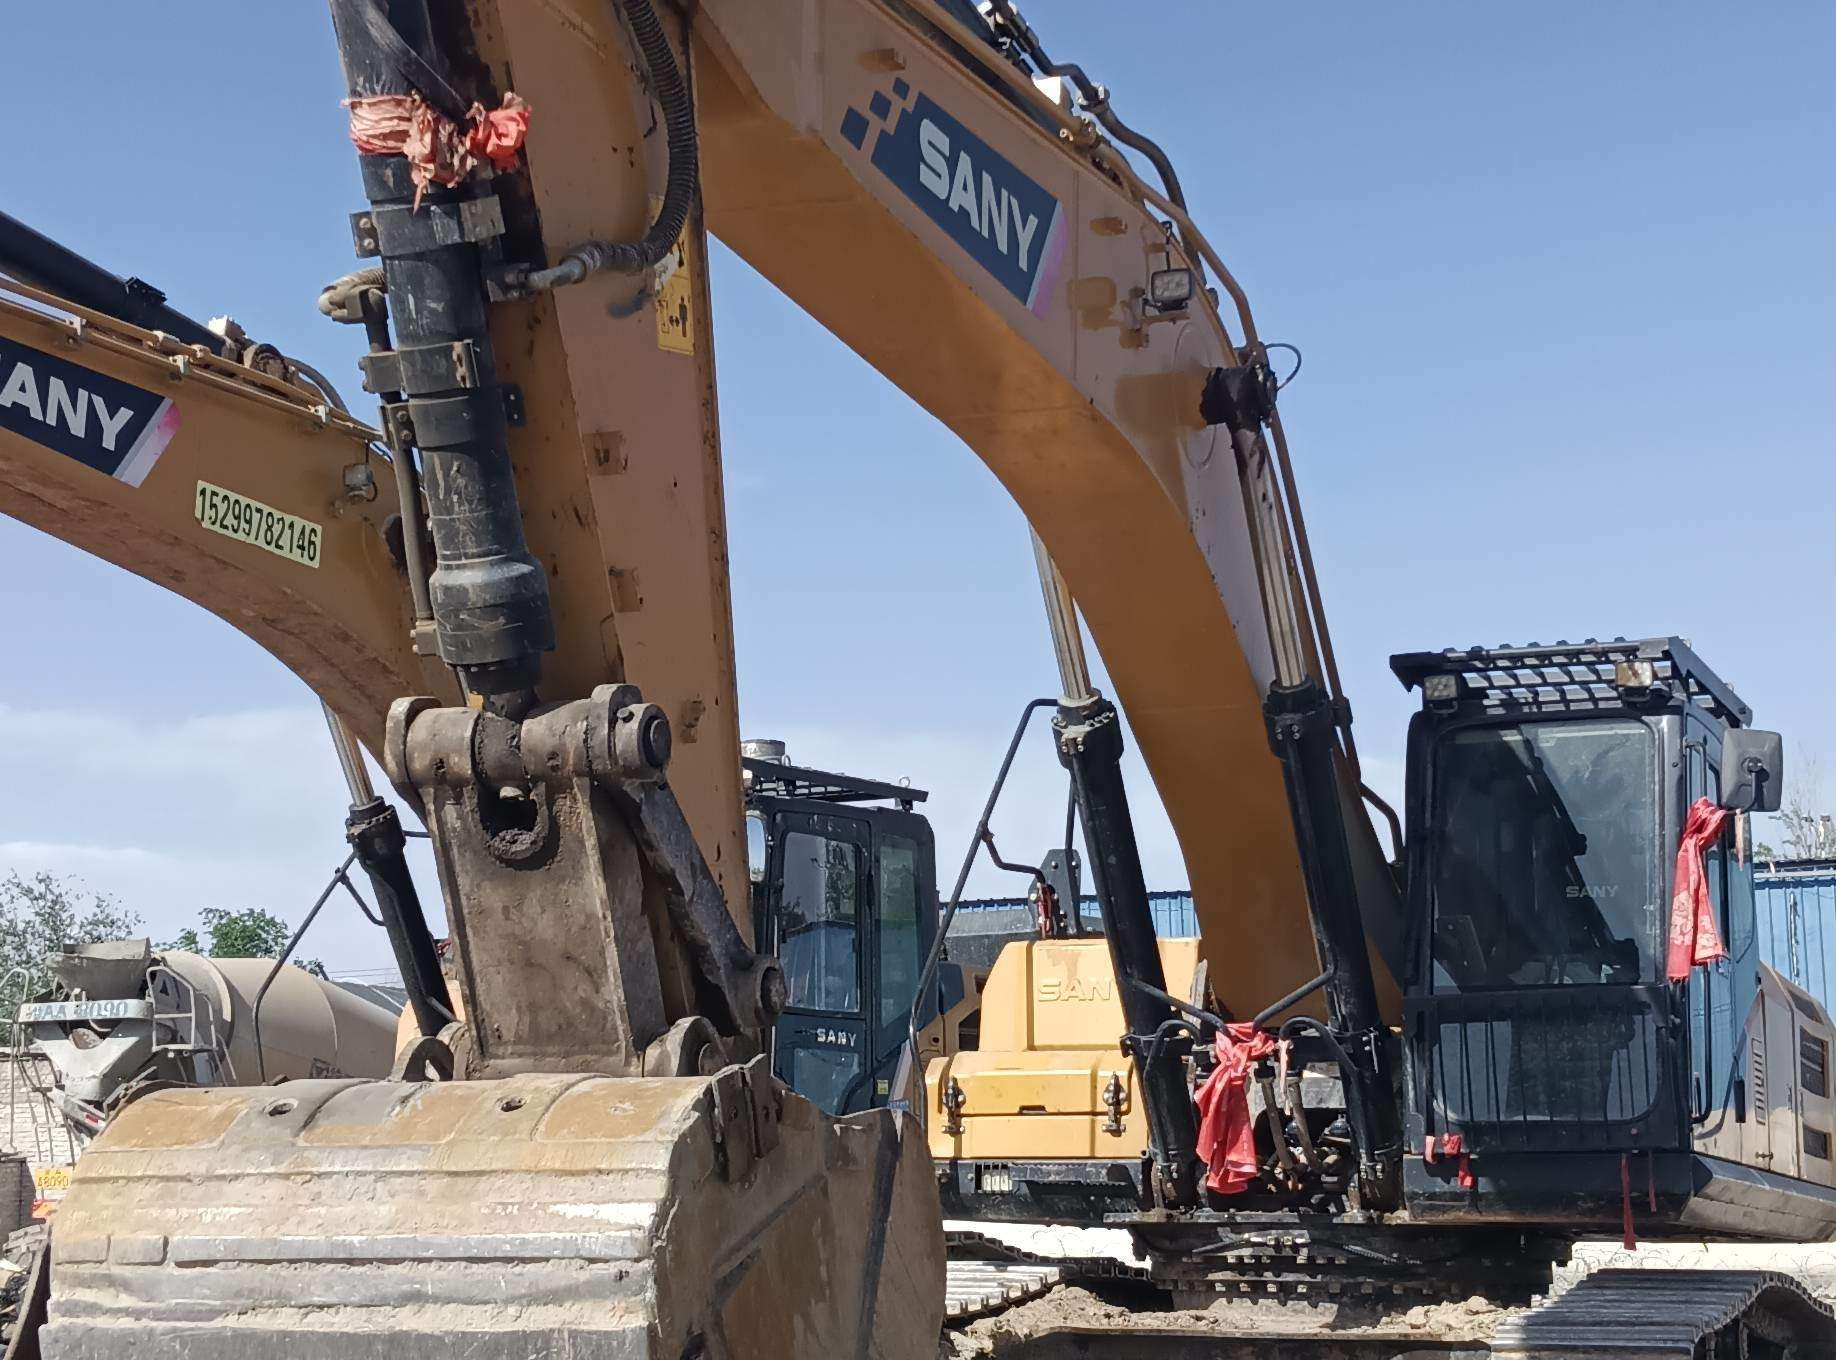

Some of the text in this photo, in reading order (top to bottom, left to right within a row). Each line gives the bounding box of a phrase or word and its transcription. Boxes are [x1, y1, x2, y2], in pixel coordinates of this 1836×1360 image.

[920, 118, 1038, 272] SANY
[0, 353, 134, 451] ANY
[200, 487, 318, 561] 15299782146
[1566, 886, 1618, 897] SANY
[1038, 977, 1112, 1002] SAN
[817, 1028, 856, 1047] SANY
